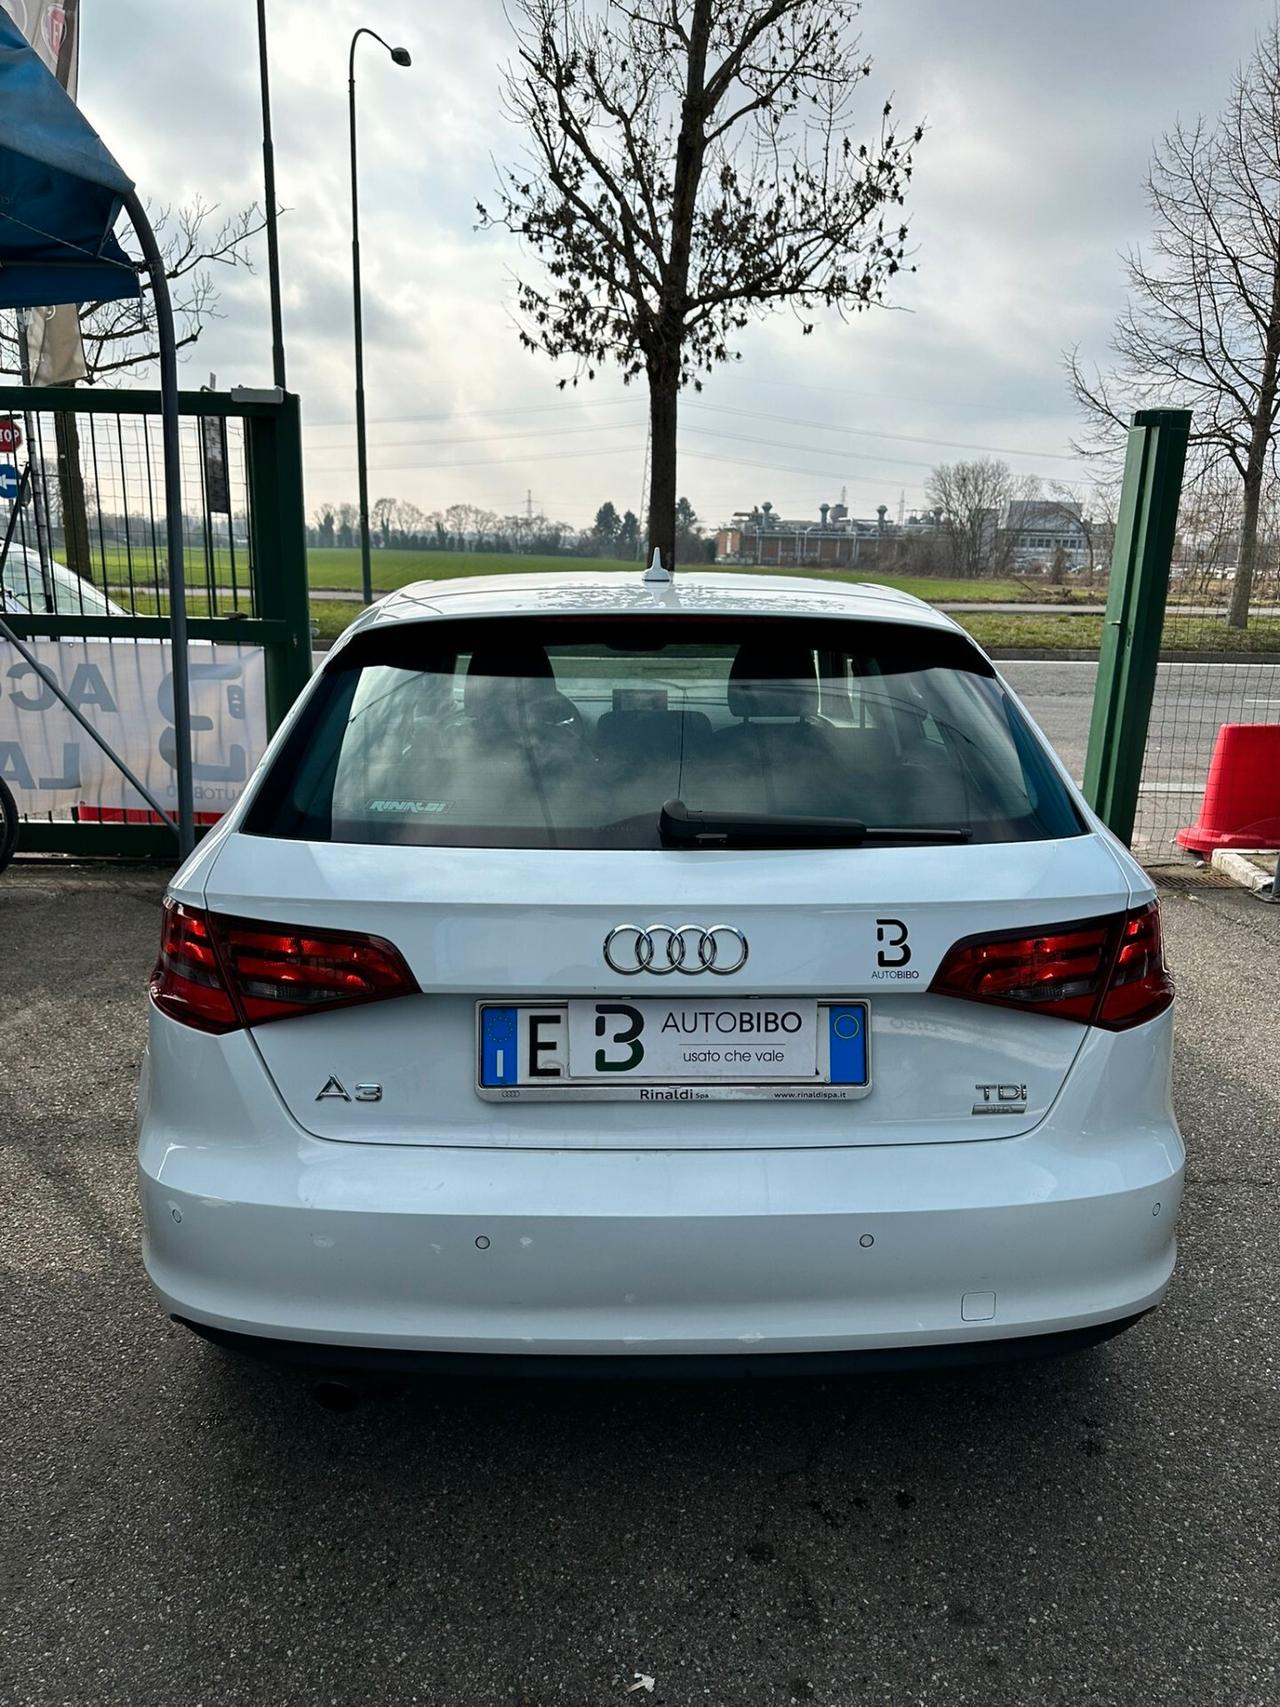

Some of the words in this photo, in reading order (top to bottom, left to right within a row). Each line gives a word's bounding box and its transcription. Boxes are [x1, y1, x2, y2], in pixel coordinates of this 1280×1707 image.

[871, 969, 920, 980] AUTOBIBO
[661, 1011, 803, 1034] AUTOBIBO
[683, 1050, 721, 1063] usato
[724, 1049, 752, 1063] che
[756, 1049, 785, 1063] vale
[314, 1073, 384, 1102] A3
[639, 1088, 694, 1100] Rinaldi
[695, 1091, 710, 1100] Spa
[974, 1083, 1028, 1101] TDI
[773, 1090, 847, 1100] www.rinaldispa.it
